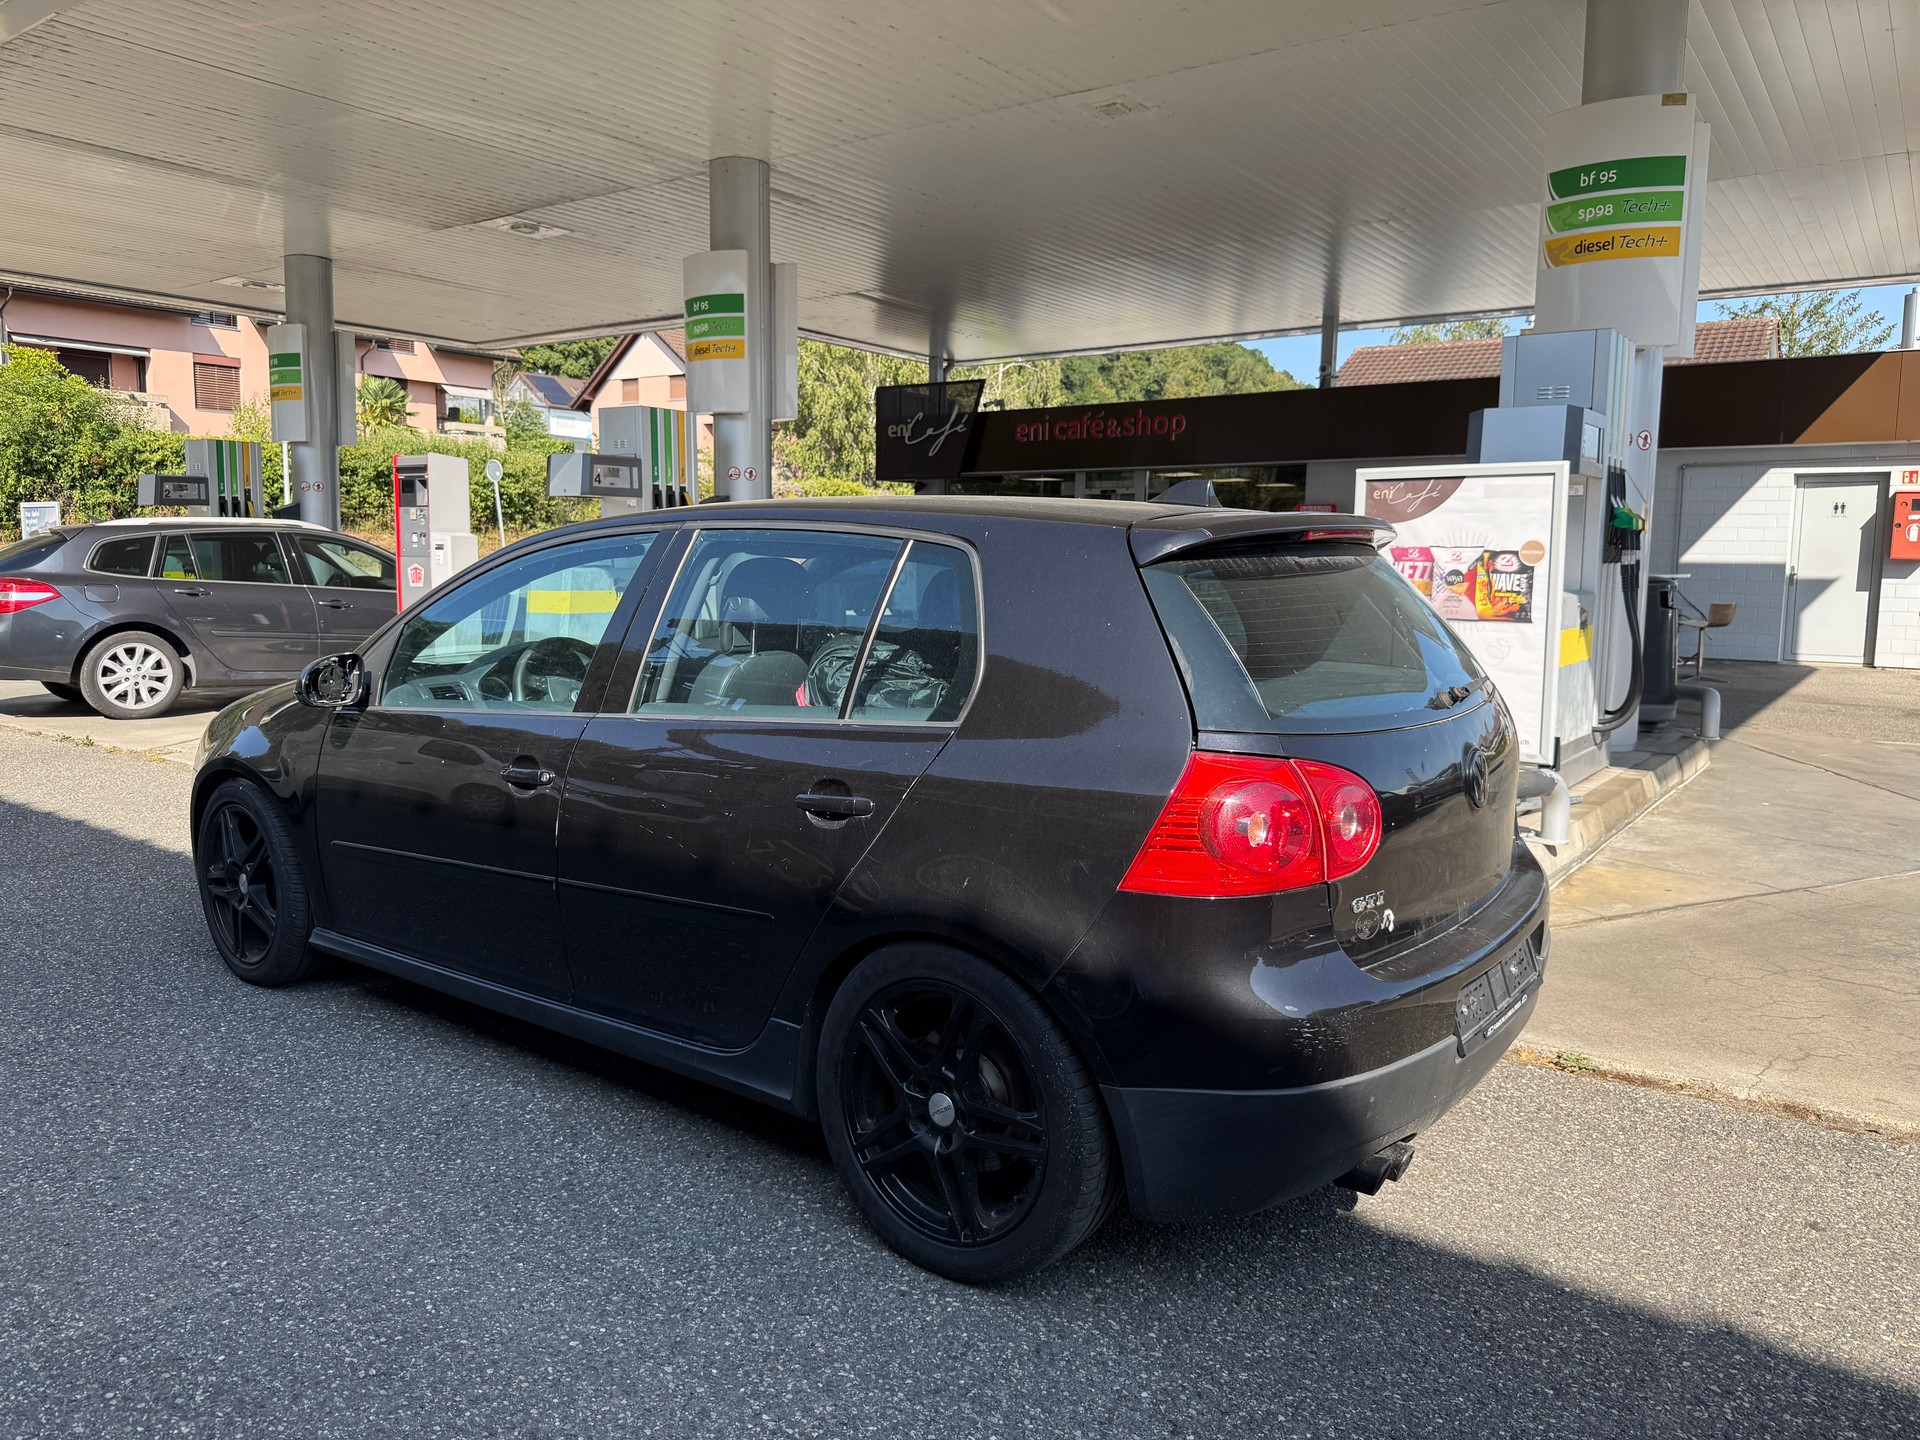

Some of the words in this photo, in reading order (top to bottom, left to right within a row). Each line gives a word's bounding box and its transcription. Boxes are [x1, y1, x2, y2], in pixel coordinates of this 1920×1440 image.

[1580, 171, 1597, 187] bf
[1599, 169, 1617, 184] 95
[1578, 204, 1614, 222] sp98
[1621, 199, 1670, 214] Tech+
[1574, 236, 1615, 255] diesel
[1619, 234, 1668, 249] Tech+
[700, 301, 709, 311] 95
[711, 343, 738, 353] Tech+
[887, 418, 912, 438] eni
[905, 405, 969, 457] Café
[1014, 414, 1049, 443] eni
[594, 473, 602, 485] 4
[164, 489, 171, 498] 2
[1373, 486, 1393, 499] eni
[1387, 479, 1441, 513] Café
[1351, 890, 1385, 914] GTI
